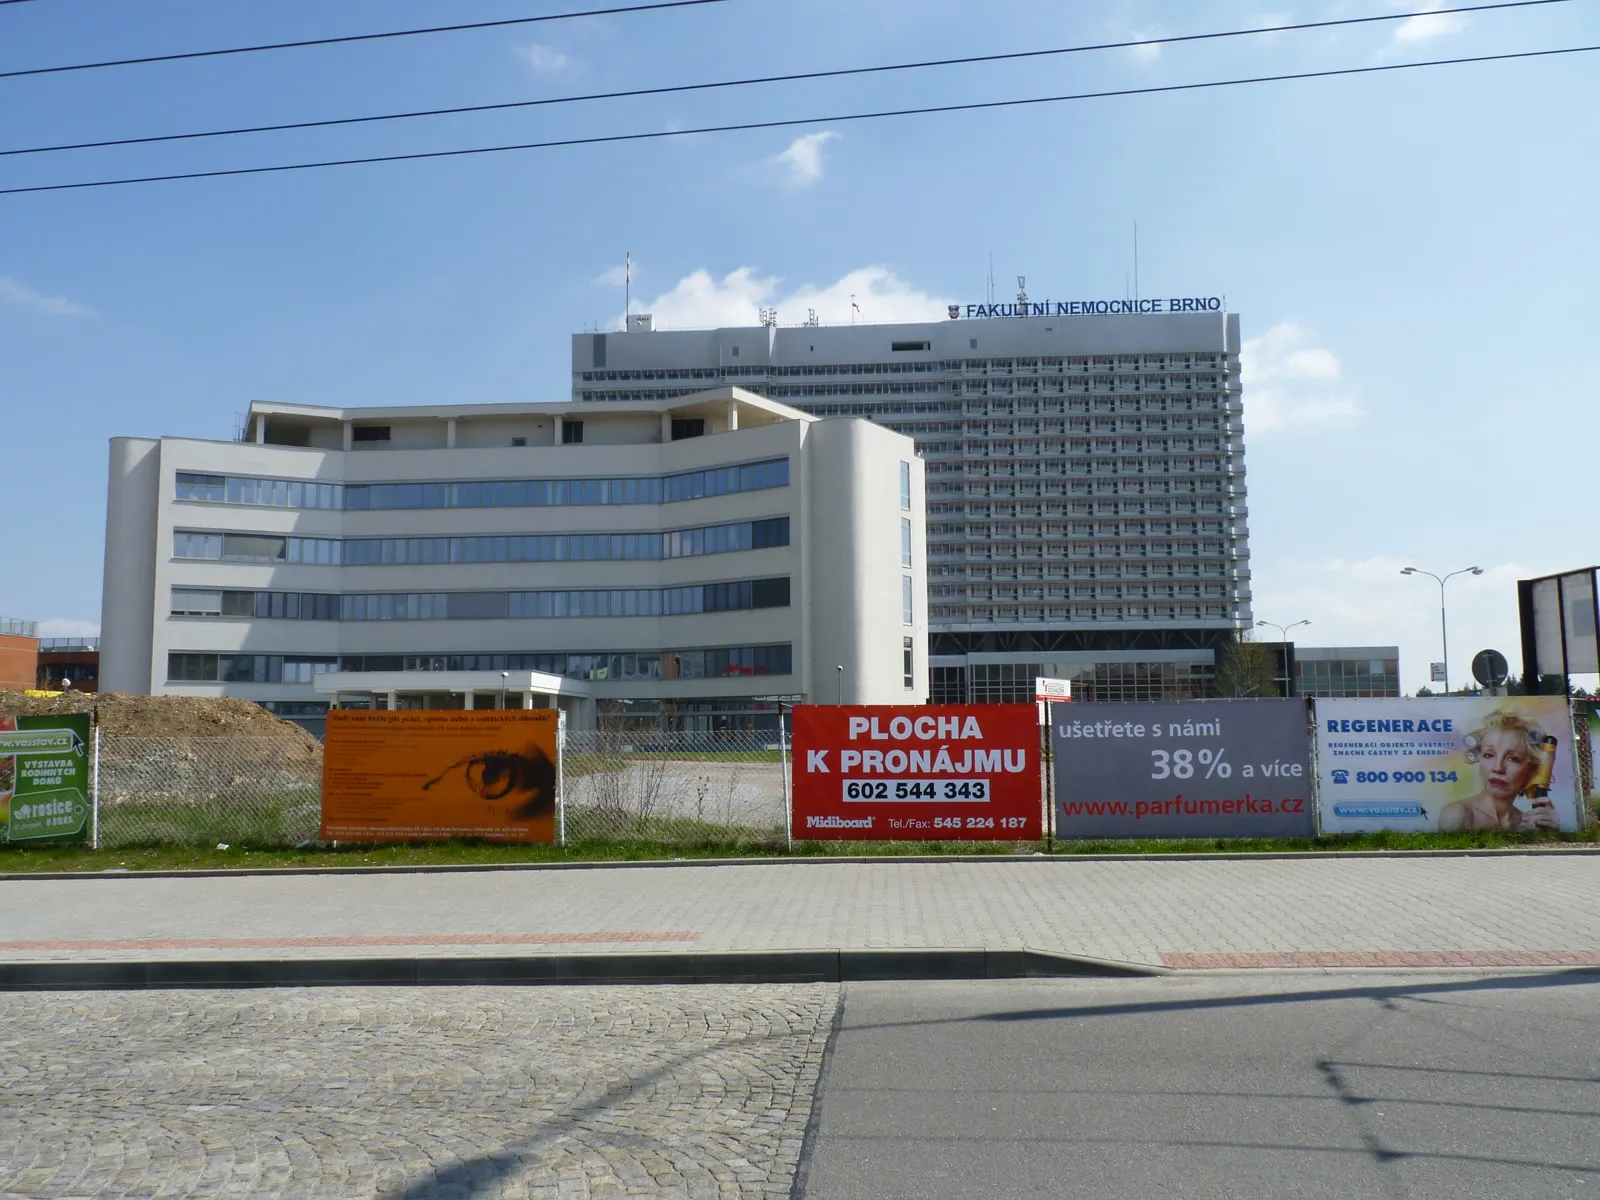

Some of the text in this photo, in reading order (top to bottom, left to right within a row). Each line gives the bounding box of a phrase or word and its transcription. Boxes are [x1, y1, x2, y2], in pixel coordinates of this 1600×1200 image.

[966, 297, 1220, 318] FAKULTNÍ NEMOCNICE BRNO
[849, 716, 983, 740] PLOCHA
[1059, 718, 1221, 739] ušetřete s námi
[1327, 719, 1453, 733] REGENERACE
[807, 745, 1026, 774] K PRONÁJMU
[1151, 748, 1303, 780] 38% a více
[1356, 771, 1458, 783] 800 900 134
[847, 782, 986, 799] 602 544 343
[1062, 793, 1305, 820] www.parfumerka.cz
[888, 817, 1027, 829] Tel./Fax: 545 224 187
